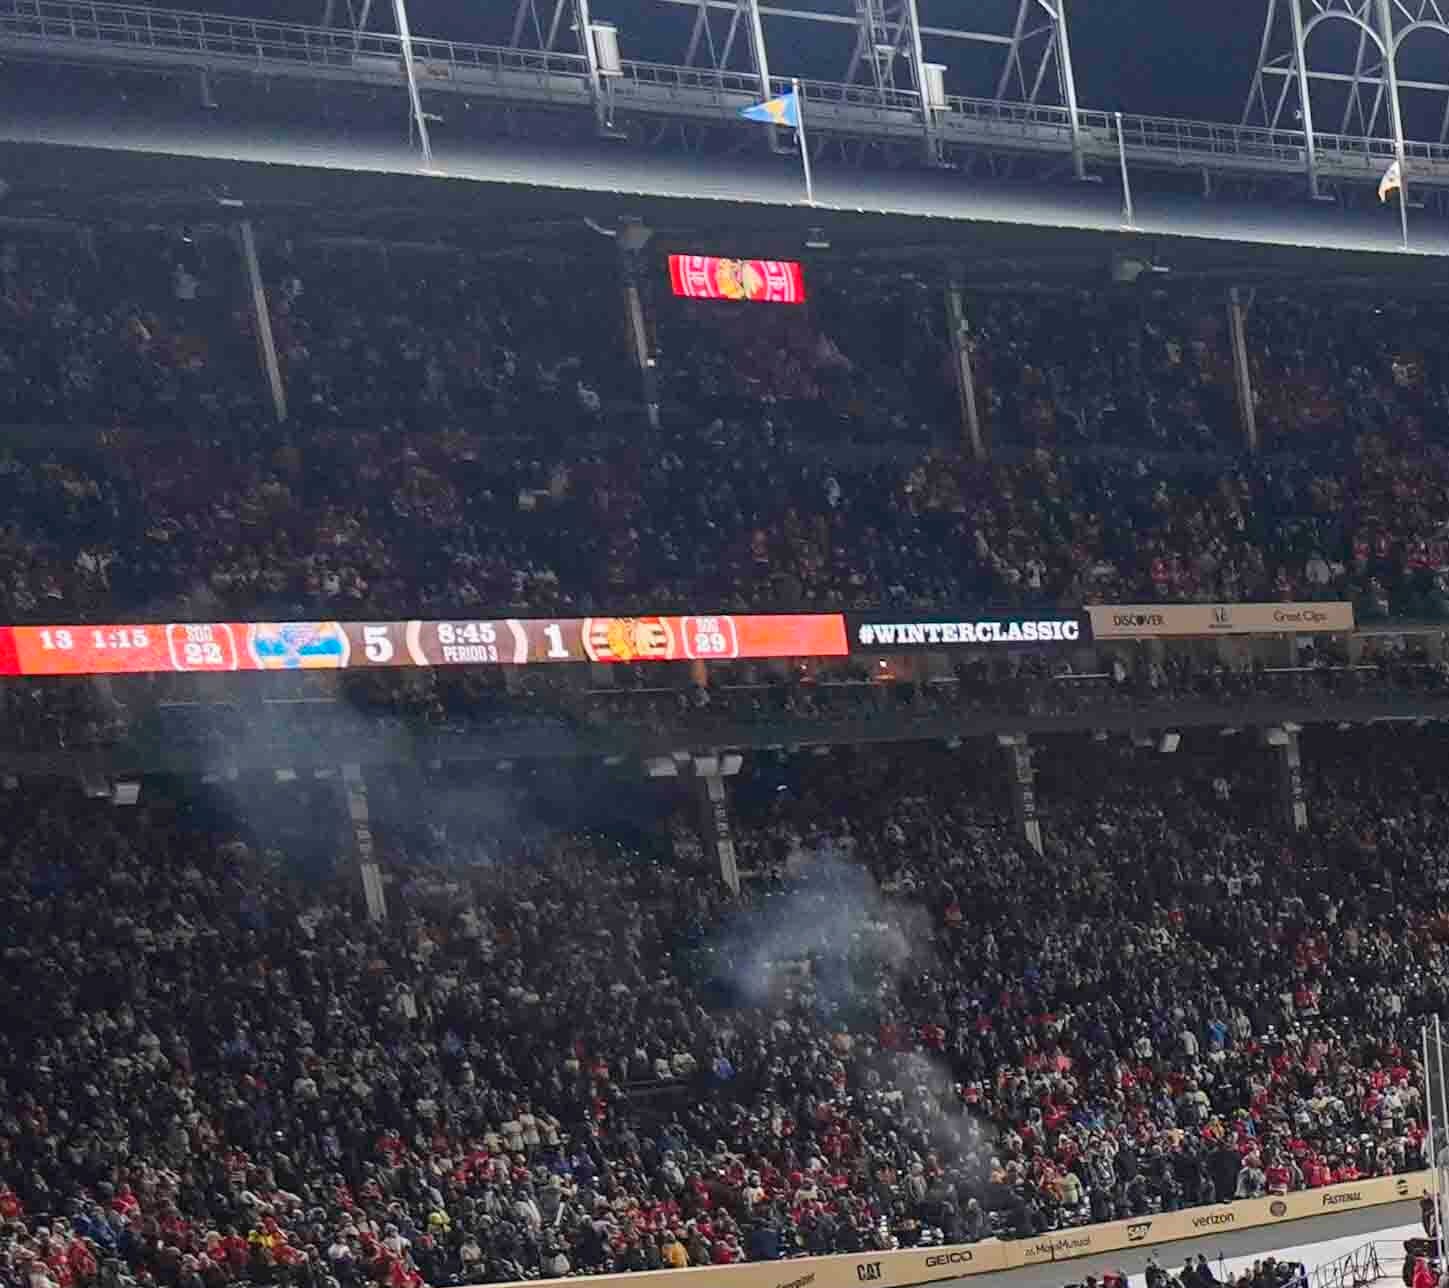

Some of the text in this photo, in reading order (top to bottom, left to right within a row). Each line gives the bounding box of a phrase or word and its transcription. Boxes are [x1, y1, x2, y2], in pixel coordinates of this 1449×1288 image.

[1113, 614, 1165, 627] DISCOVER
[93, 629, 149, 648] 1:15
[437, 622, 496, 644] 8:45
[544, 624, 568, 658] 1
[858, 620, 1080, 645] #WINTERCLASSIC
[364, 627, 394, 662] 5
[443, 646, 484, 662] PERIOD
[1191, 1212, 1235, 1228] verizon
[922, 1250, 971, 1267] GEICO
[855, 1262, 881, 1281] CAT
